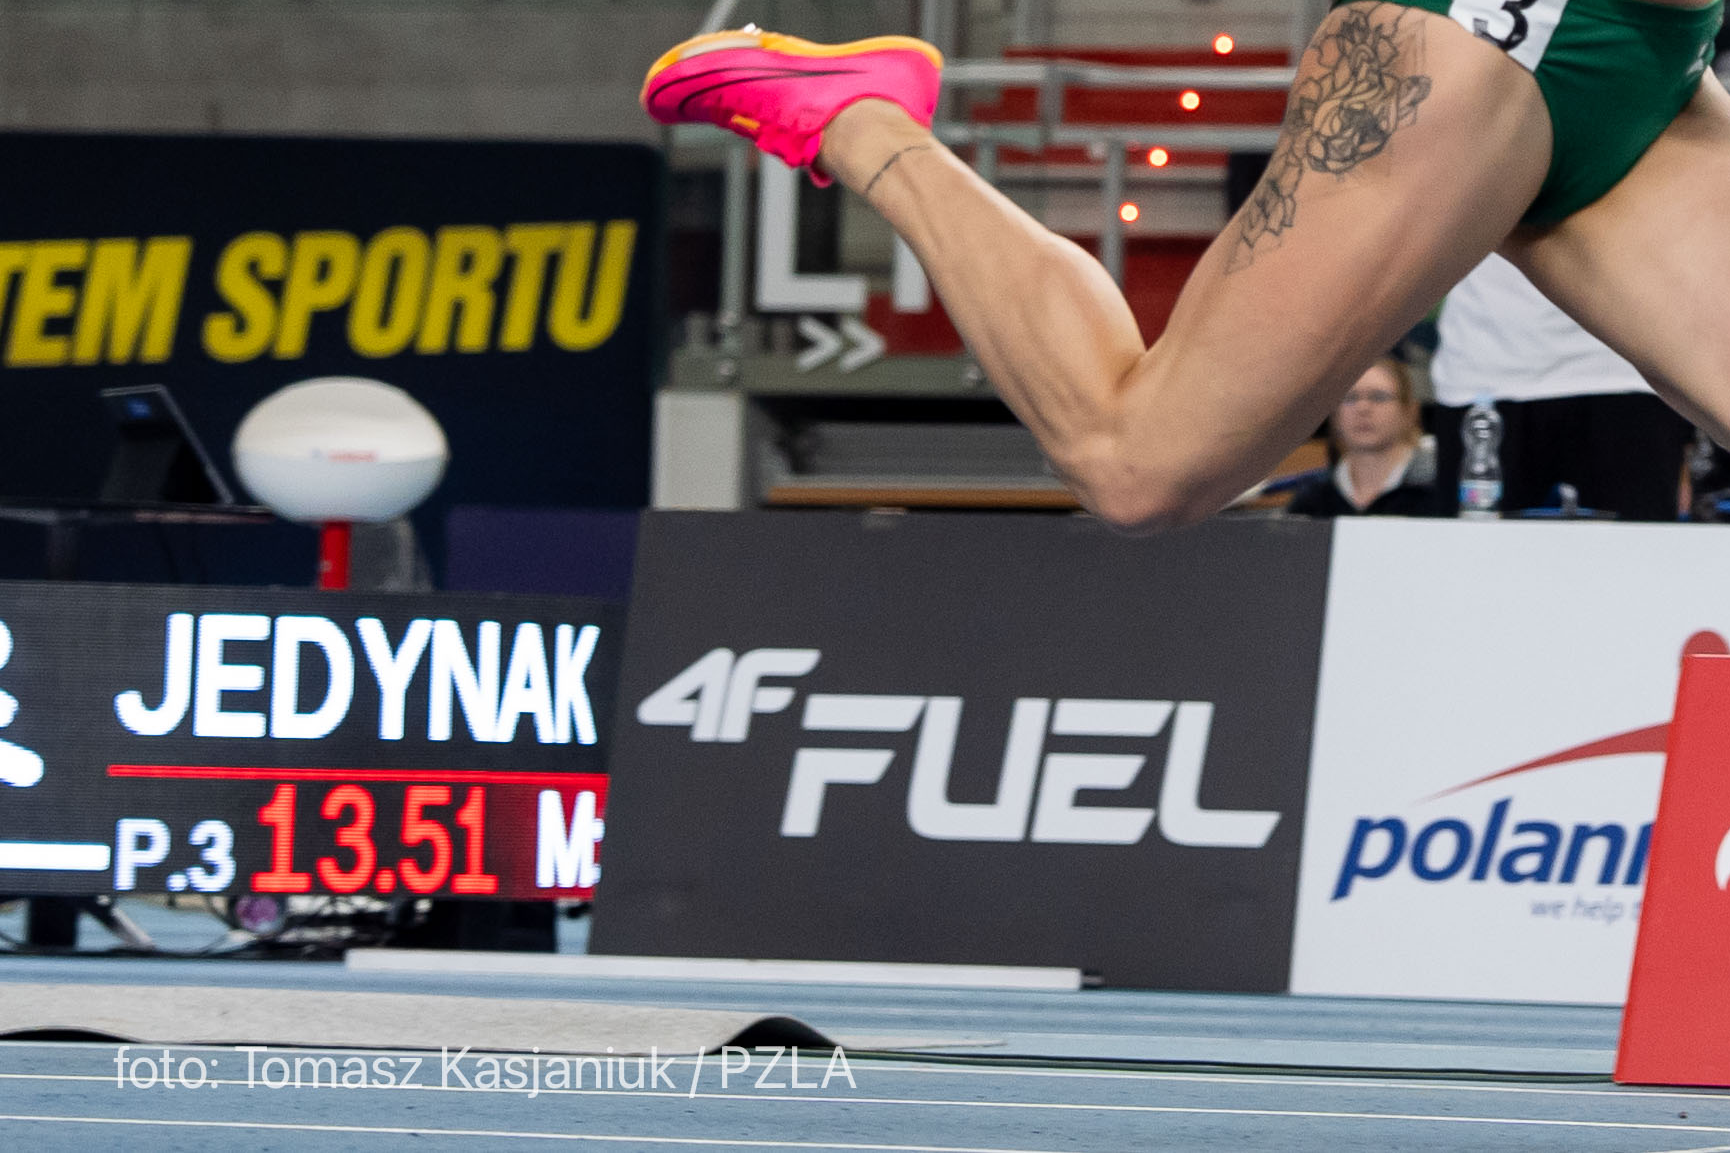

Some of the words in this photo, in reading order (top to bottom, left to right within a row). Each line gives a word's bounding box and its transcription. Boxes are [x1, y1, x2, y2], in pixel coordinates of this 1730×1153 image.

[203, 220, 637, 363] SPORTU
[114, 612, 600, 744] JEDYNAK
[637, 647, 821, 742] 4F
[779, 694, 1281, 847] FUEL
[114, 818, 236, 892] P.3
[250, 784, 498, 893] 13.51
